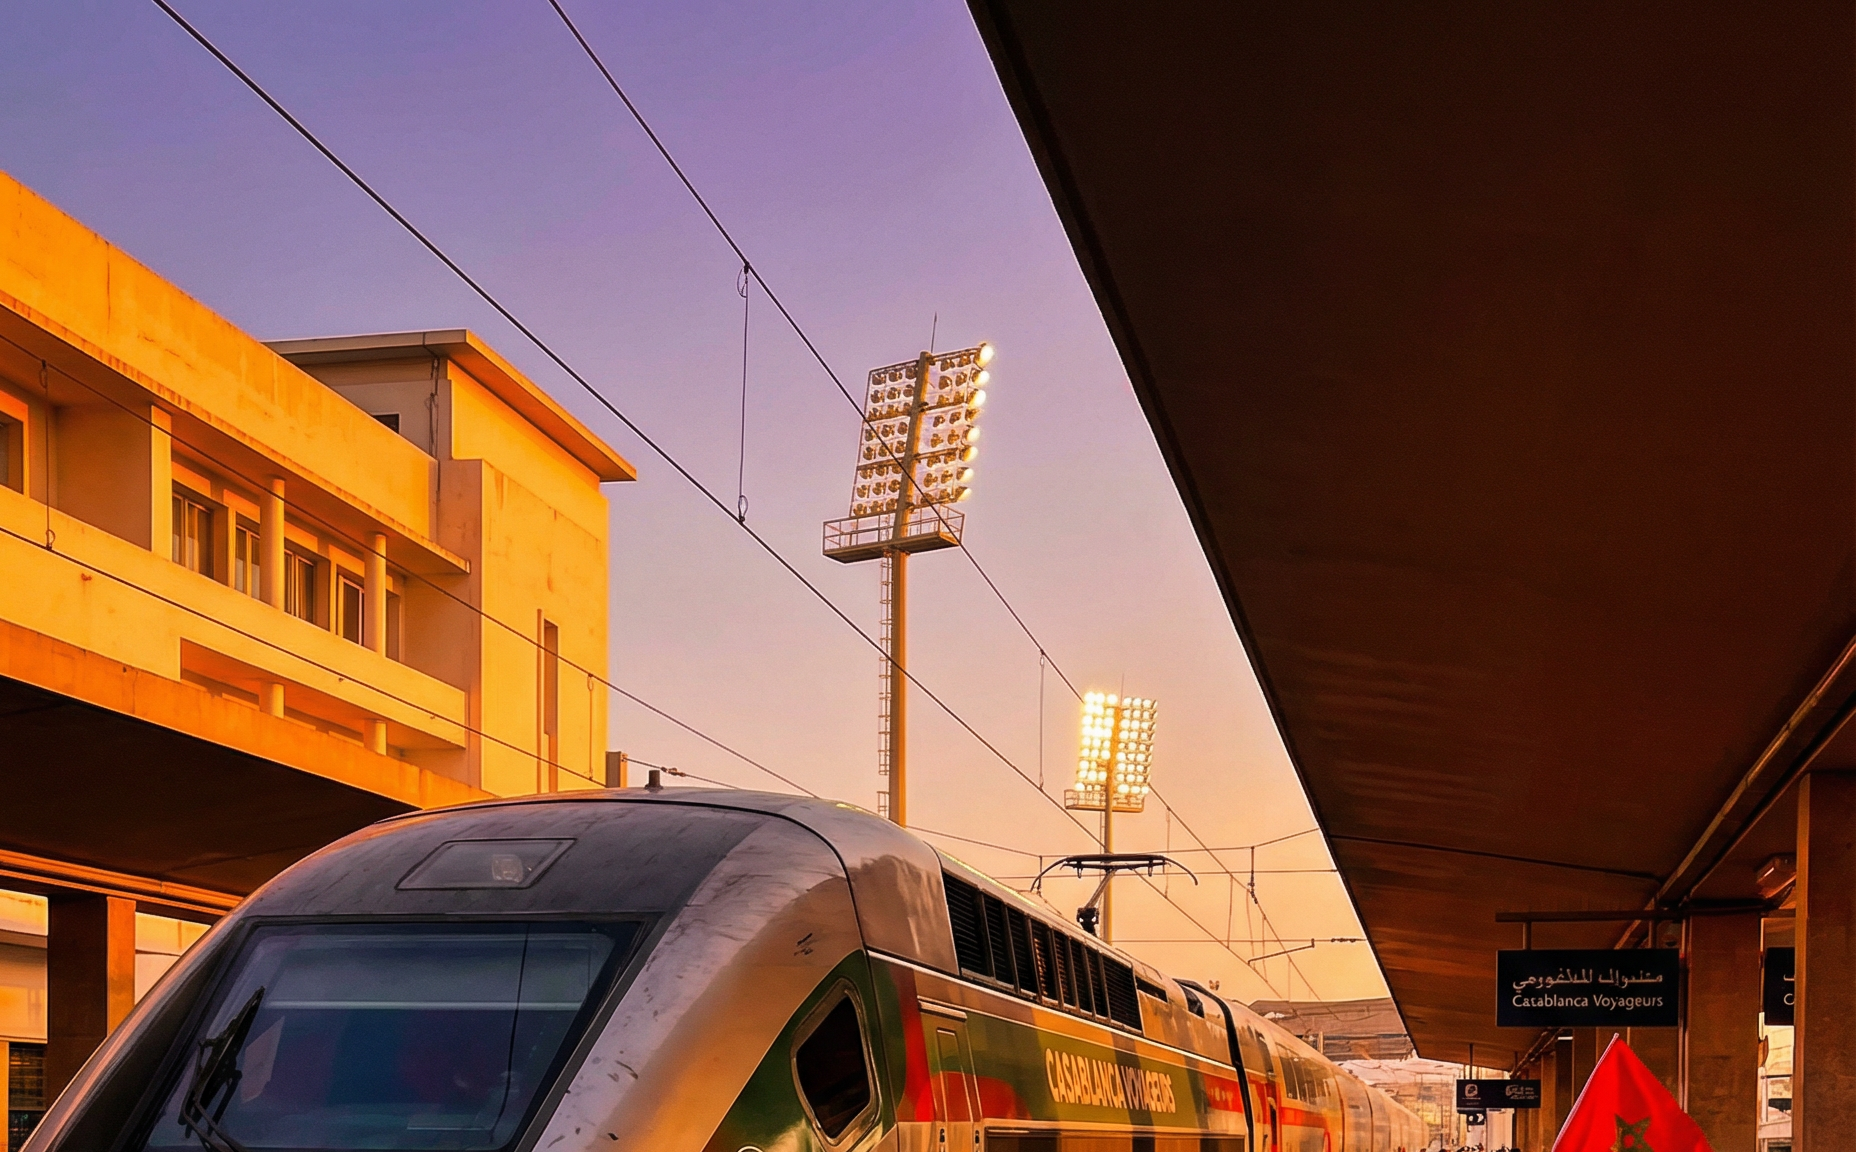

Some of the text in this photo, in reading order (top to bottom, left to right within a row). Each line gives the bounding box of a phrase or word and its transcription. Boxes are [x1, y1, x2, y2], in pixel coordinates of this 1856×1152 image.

[1512, 993, 1664, 1011] Casablanca Voyageurs
[1045, 1048, 1128, 1109] CASABLANCA
